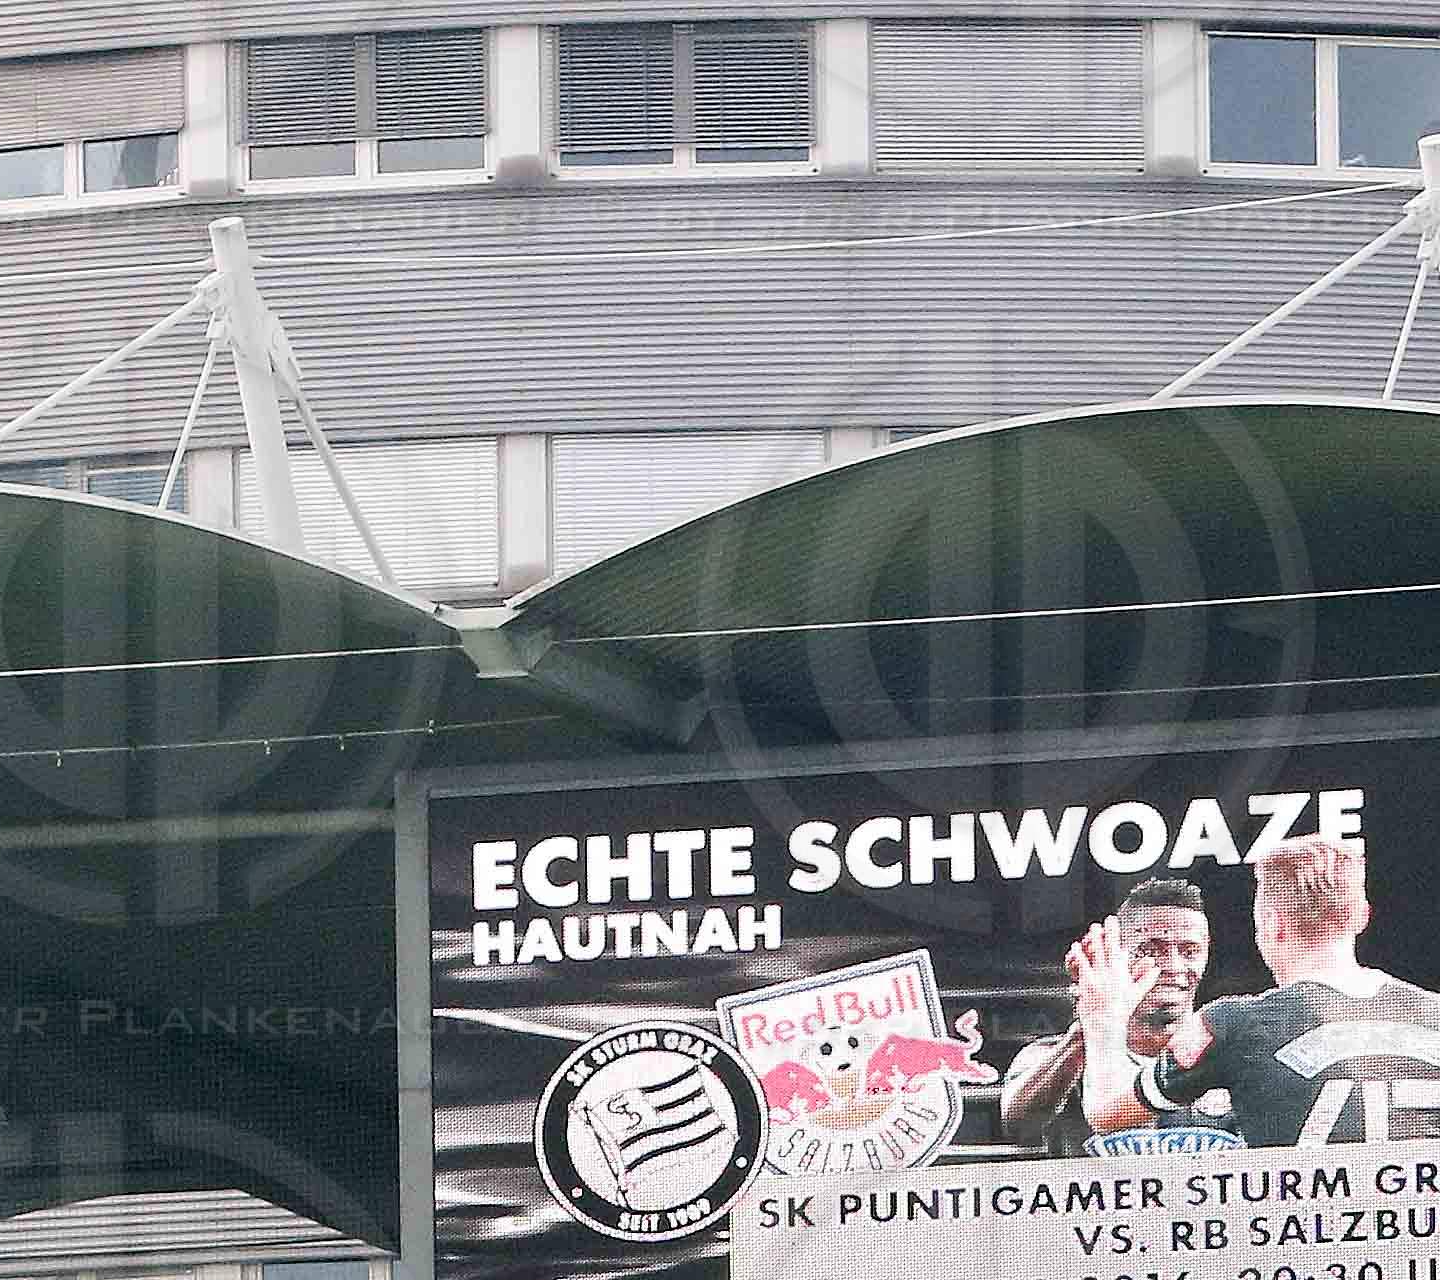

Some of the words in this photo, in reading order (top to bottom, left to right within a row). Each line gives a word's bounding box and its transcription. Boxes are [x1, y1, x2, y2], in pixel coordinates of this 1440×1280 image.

[472, 826, 757, 911] ECHTE
[789, 788, 1366, 893] SCHWOAZE
[472, 904, 783, 966] HAUTNAH
[741, 998, 826, 1050] Red
[836, 973, 921, 1027] Bull
[759, 1196, 816, 1229] SK
[839, 1178, 1165, 1227] PUNTIGAMER
[1187, 1166, 1352, 1207] STURM
[1075, 1224, 1148, 1256] VS.
[1171, 1218, 1229, 1252] RB
